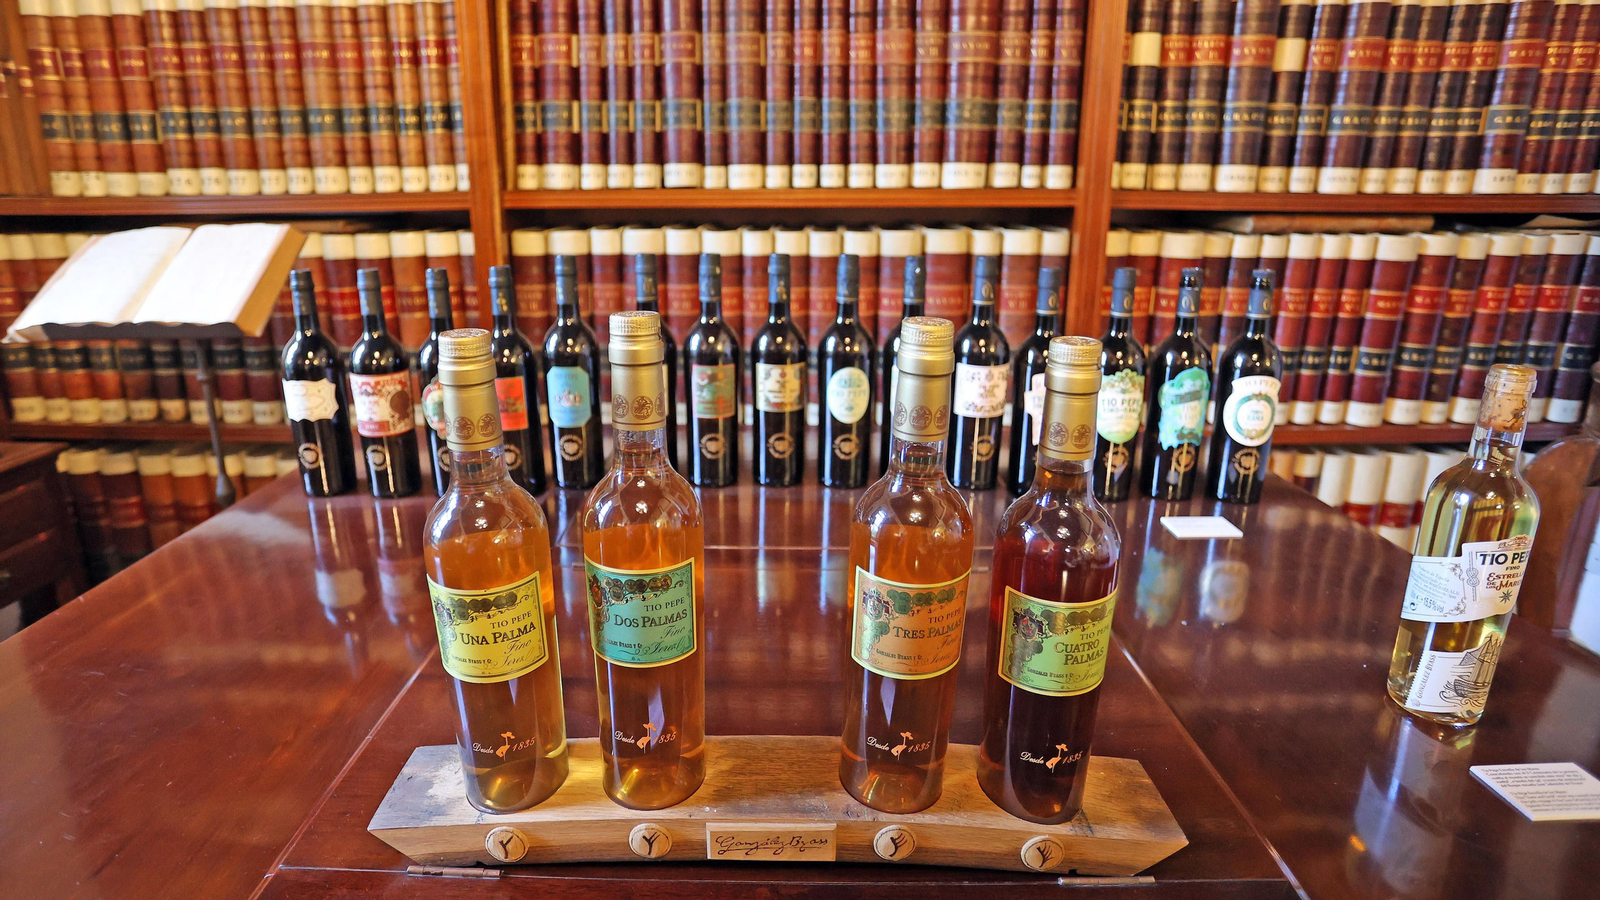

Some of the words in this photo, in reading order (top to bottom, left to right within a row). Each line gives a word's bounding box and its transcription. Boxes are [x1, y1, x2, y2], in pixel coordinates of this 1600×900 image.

[1479, 553, 1509, 566] TIO
[644, 604, 662, 612] TIO
[665, 597, 685, 609] PEPE
[490, 620, 508, 629] TIO
[512, 611, 532, 624] PEPE
[614, 614, 639, 628] DOS
[641, 609, 688, 628] PALMAS
[928, 615, 944, 624] TIO
[946, 607, 961, 619] PEPE
[460, 632, 490, 645] UNA
[491, 622, 536, 644] PALMA
[660, 625, 686, 640] Fino
[892, 626, 925, 639] TRES
[927, 617, 962, 638] PALMAS
[1079, 632, 1096, 641] TIO
[504, 638, 532, 654] Fino
[650, 639, 677, 655] Jerez
[1054, 639, 1100, 654] CUATRO
[499, 654, 524, 668] Jerez
[1063, 646, 1105, 666] PALMAS
[1415, 668, 1432, 698] GONZALEZ
[1427, 653, 1437, 670] BYASS
[472, 741, 494, 755] Desde
[511, 735, 536, 753] 1835
[614, 730, 635, 744] Desde
[653, 730, 677, 745] 1835
[866, 736, 890, 751] Desde
[906, 740, 931, 753] 1835
[1019, 751, 1044, 765] Desde
[1062, 750, 1084, 765] 1835
[715, 835, 790, 855] González
[788, 835, 828, 852] Byass
